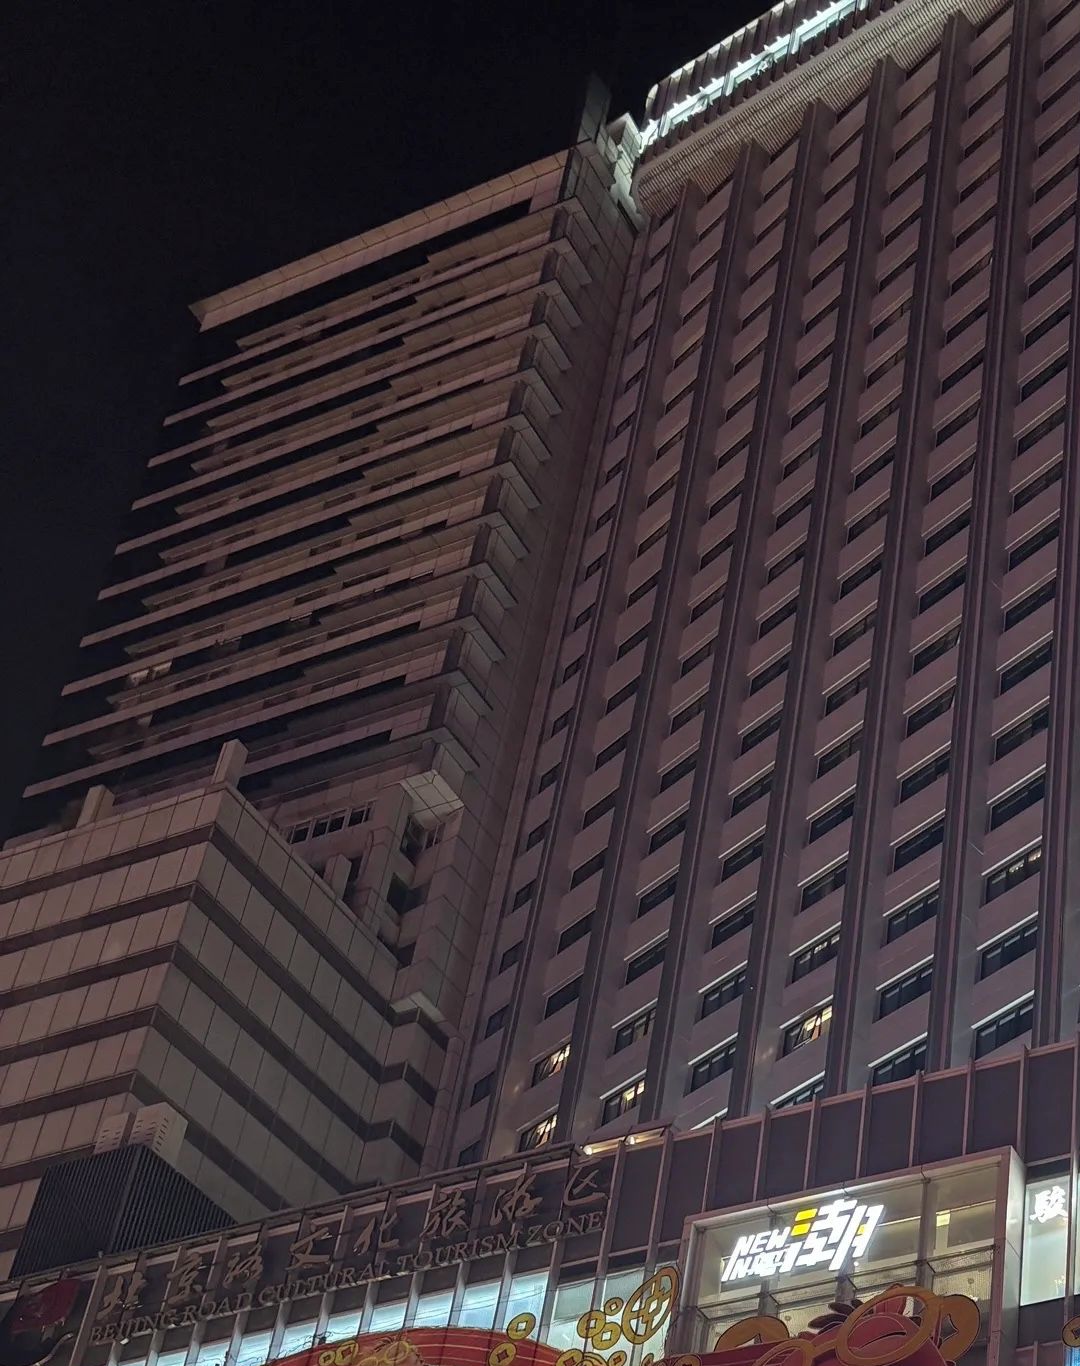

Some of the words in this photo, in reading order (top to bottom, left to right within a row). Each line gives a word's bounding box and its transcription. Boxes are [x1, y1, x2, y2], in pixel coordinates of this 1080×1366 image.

[91, 1303, 180, 1342] BEIJING
[184, 1291, 252, 1324] ROAD
[257, 1258, 391, 1305] CULTURAL
[396, 1230, 520, 1270] TOURISM
[525, 1211, 604, 1246] ZONE
[737, 1226, 791, 1257] NEW
